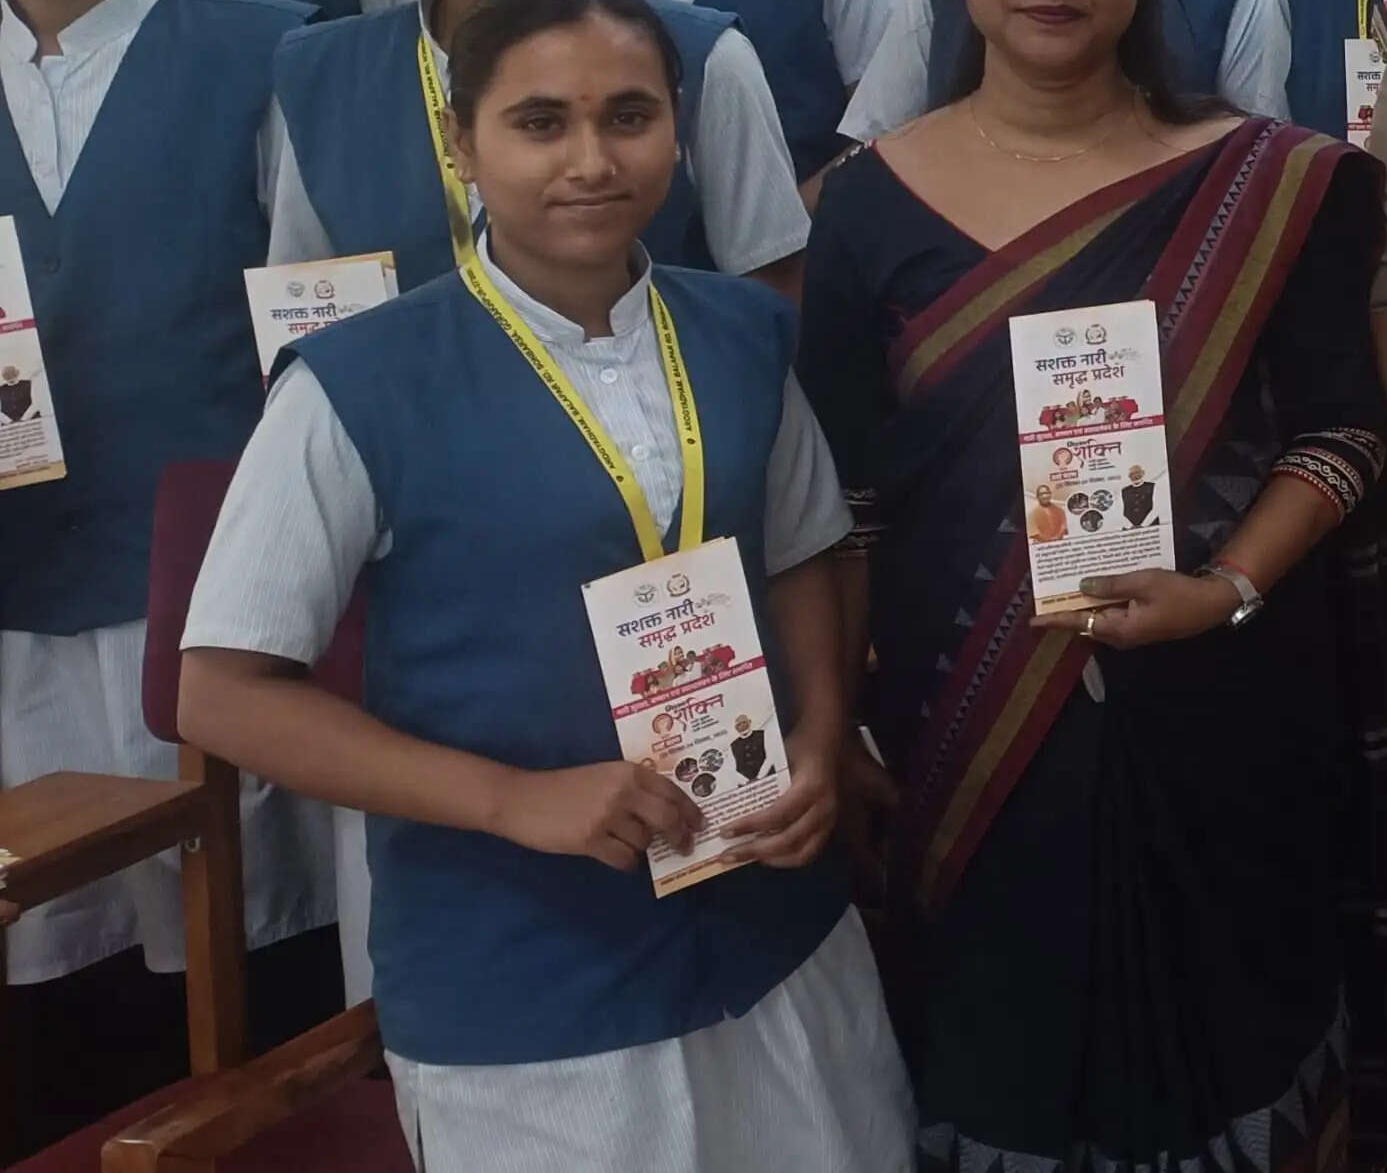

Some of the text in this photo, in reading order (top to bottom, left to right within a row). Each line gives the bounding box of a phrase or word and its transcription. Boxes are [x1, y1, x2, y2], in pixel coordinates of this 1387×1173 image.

[270, 303, 337, 320] सशक्त नारी
[1036, 348, 1107, 372] सशक्त नारी
[1052, 364, 1125, 389] समृद्ध प्रदेश
[617, 598, 695, 637] सशक्त नारी
[638, 612, 716, 649] समृद्ध प्रदेश
